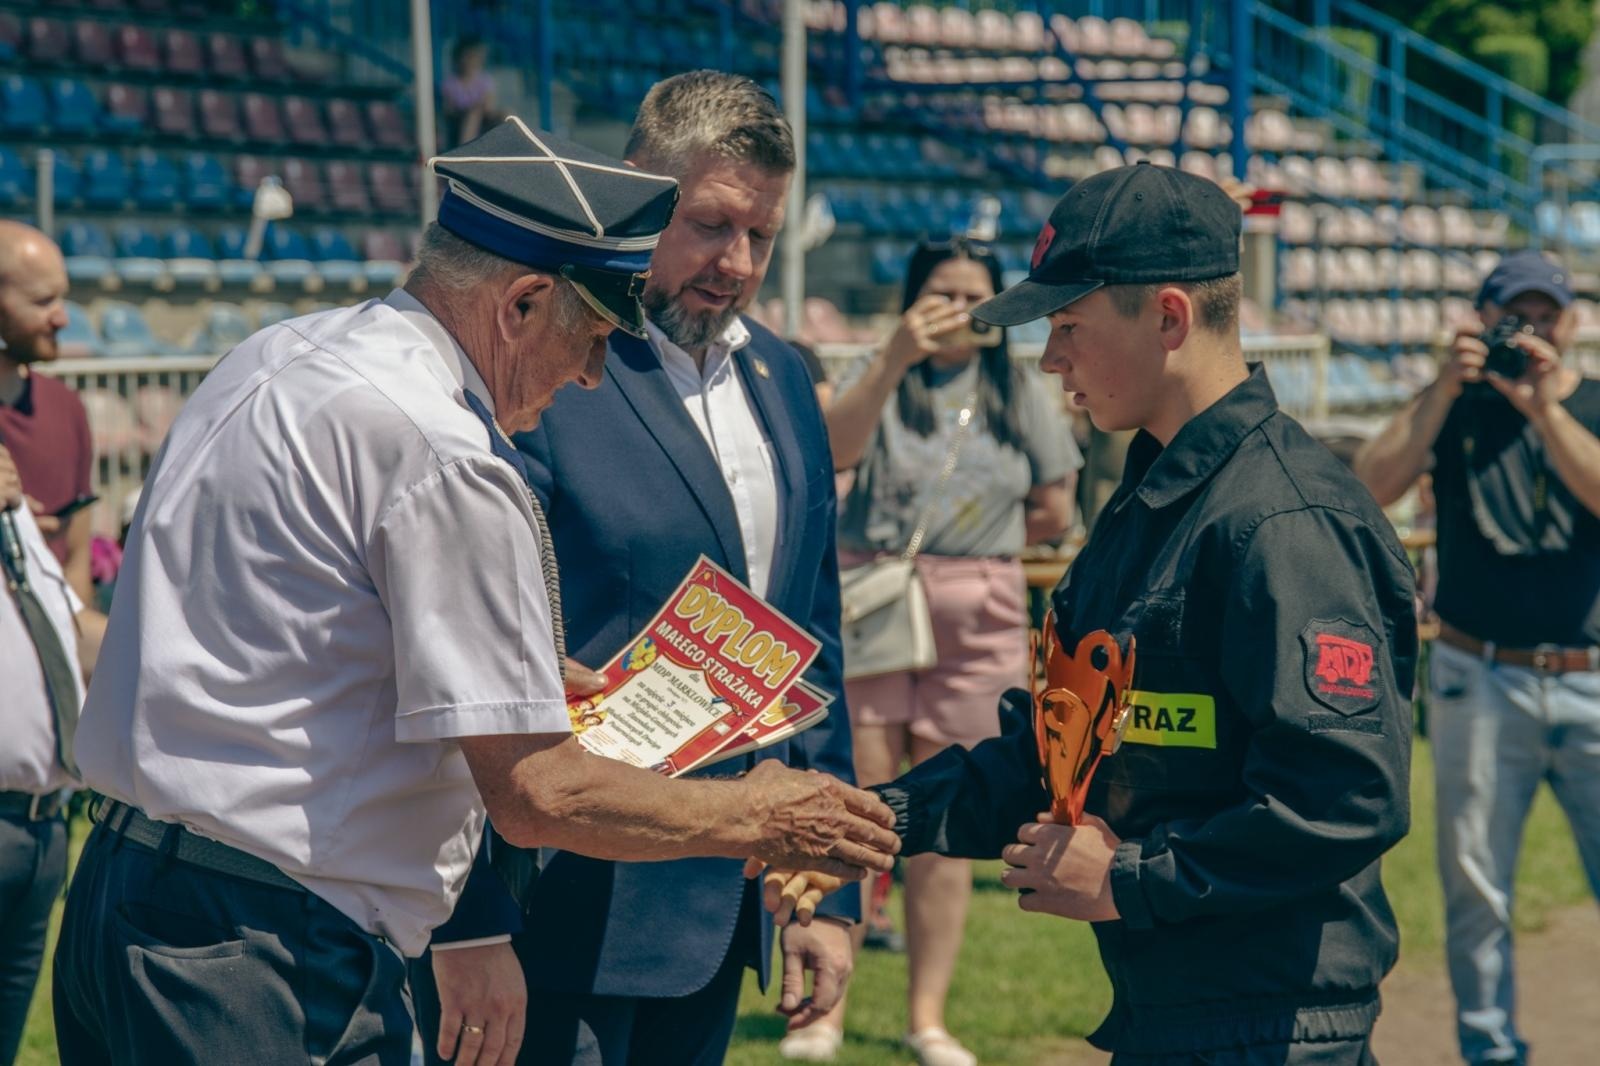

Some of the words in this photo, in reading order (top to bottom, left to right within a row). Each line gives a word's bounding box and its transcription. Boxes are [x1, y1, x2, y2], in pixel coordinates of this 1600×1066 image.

[674, 583, 801, 689] DYPLOM
[652, 662, 672, 678] MDP
[655, 620, 706, 663] MAŁEGO
[701, 656, 765, 709] STRAŻAKA
[688, 673, 700, 683] dla
[1130, 702, 1197, 733] RAZ
